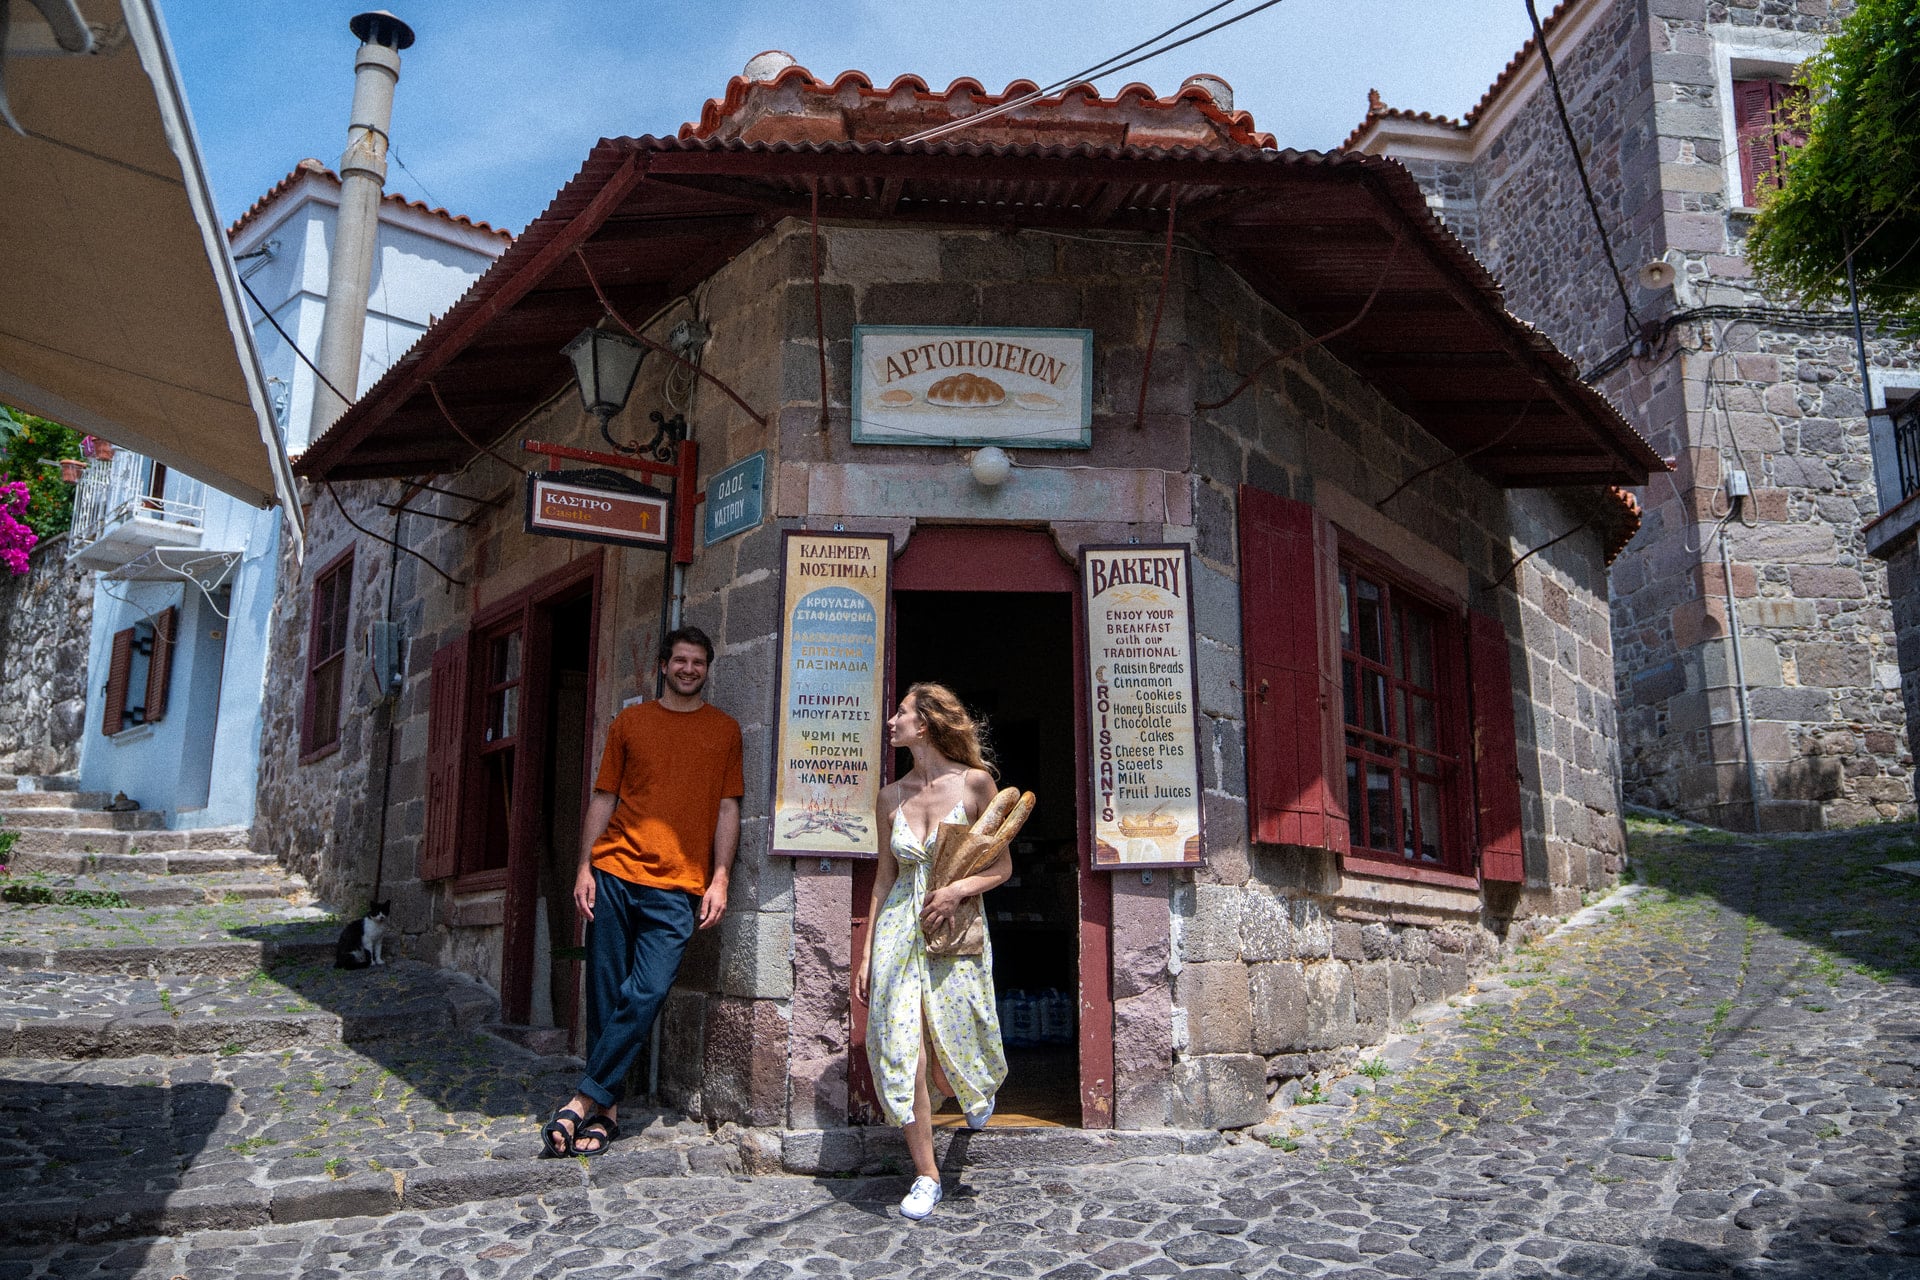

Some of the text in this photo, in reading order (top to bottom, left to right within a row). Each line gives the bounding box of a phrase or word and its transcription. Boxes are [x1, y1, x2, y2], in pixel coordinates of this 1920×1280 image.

[886, 340, 1067, 385] ΑΡΤΟΠΟΙΕΙΟΝ
[718, 473, 745, 500] ΟΔΟΣ
[545, 493, 613, 512] ΚΑΣΤΡΟ
[544, 506, 592, 521] Castle
[714, 498, 745, 529] ΚΑΣΤΡΟΥ
[800, 544, 871, 560] ΚΑΛΗΜΕΡΑ
[1090, 557, 1181, 598] BAKERY
[796, 610, 874, 623] ΣΤΑΦΙΔΟΨΩΜΑ
[1106, 609, 1174, 620] ENJOY YOUR
[1107, 623, 1171, 634] BREAKFAST
[1115, 635, 1163, 645] with our
[801, 646, 864, 658] ΕΠΤΑΖΥΜΑ
[796, 659, 869, 672] ΠΑΞΙΜΑΔΙΑ
[1113, 661, 1184, 674] Raisin Breads
[1113, 677, 1173, 688] Cinnamon
[792, 708, 871, 721] ΜΠΟΥΓΑΤΣΕΣ
[1113, 702, 1187, 718] Honey Biscuits
[1114, 716, 1172, 729] Chocolate
[801, 730, 860, 743] ΨΩΜΙ ΜΕ
[1115, 744, 1184, 757] Cheese Pies
[790, 758, 869, 772] ΚΟΥΛΟΥΡΑΚΙΑ
[1117, 758, 1163, 771] Sweets
[1118, 772, 1146, 785] Milk
[1119, 785, 1192, 799] Fruit Juices
